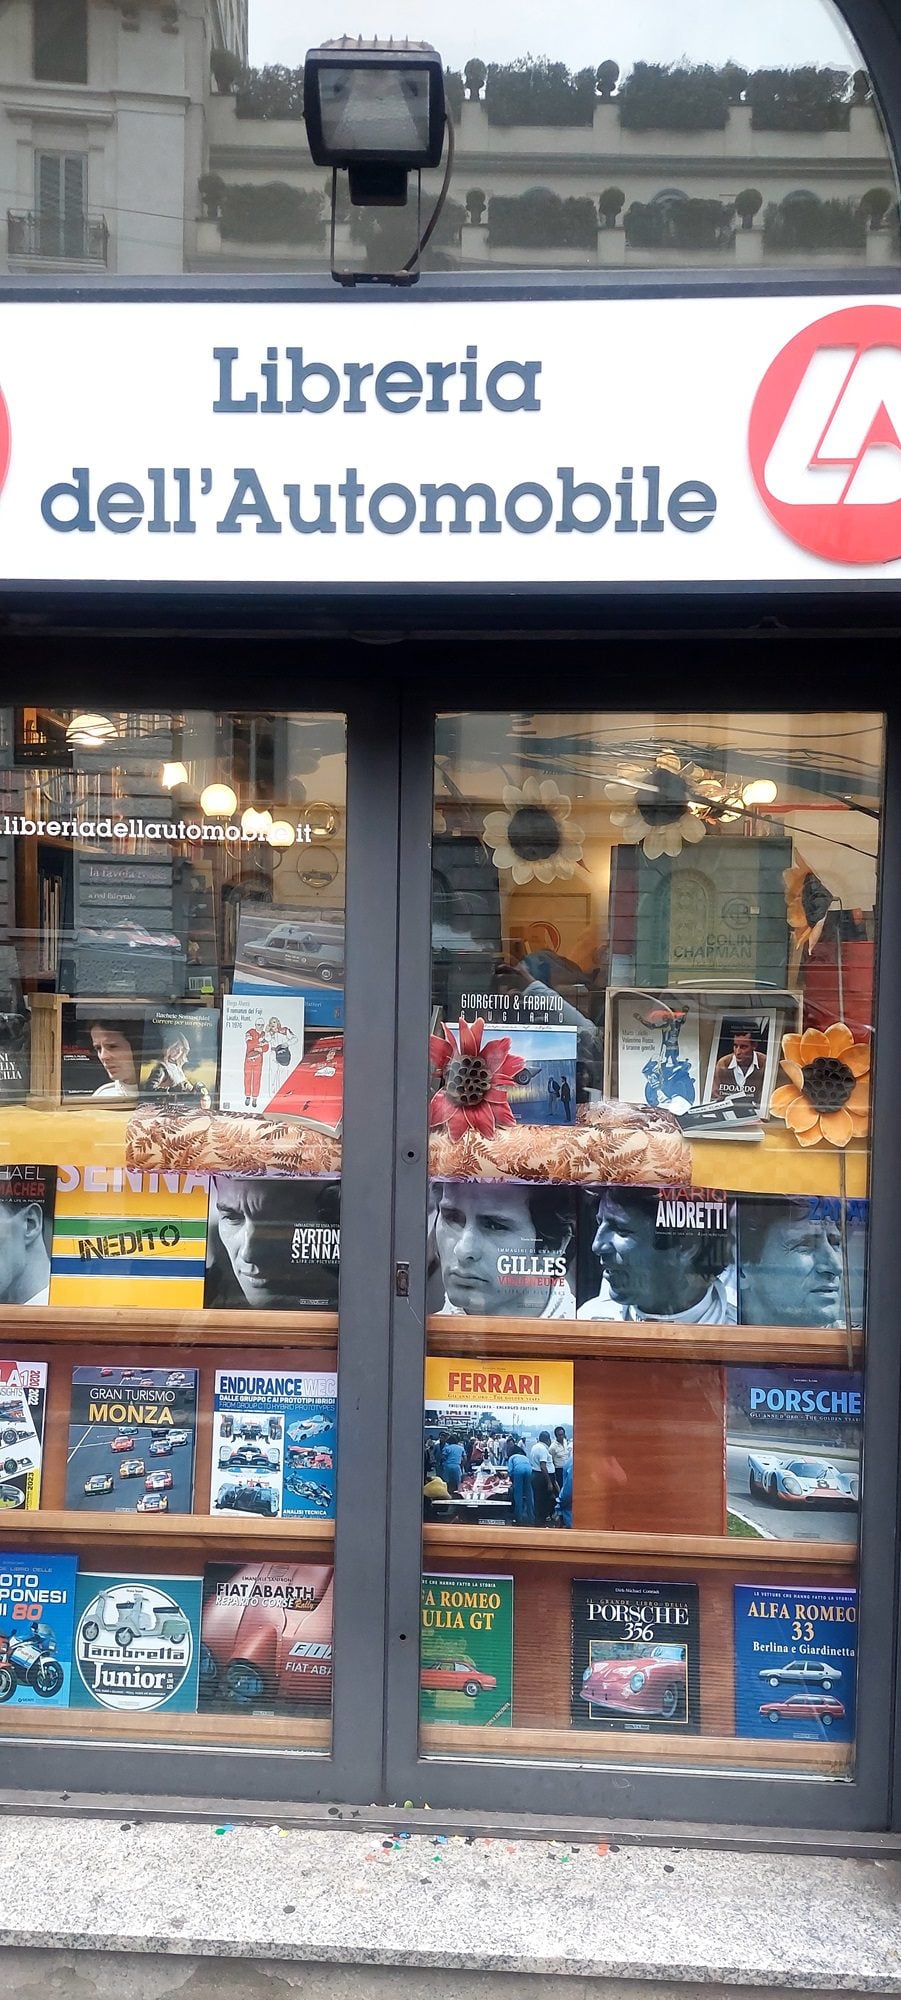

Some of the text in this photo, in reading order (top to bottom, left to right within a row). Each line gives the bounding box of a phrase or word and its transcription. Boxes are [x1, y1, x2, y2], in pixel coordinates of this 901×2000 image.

[213, 345, 542, 413] Libreria
[41, 466, 717, 533] dell’Automobile
[706, 933, 752, 947] COLIN
[674, 945, 752, 959] CHAPMAN
[461, 993, 564, 1011] GIORGETTO & FABRIZIO
[656, 1200, 728, 1230] ANDRETTI
[78, 1224, 180, 1262] INEDITO
[292, 1228, 340, 1245] AYRTON
[291, 1243, 340, 1260] SENNA
[497, 1254, 567, 1277] GILLES
[498, 1275, 565, 1288] VILLENEUVE
[219, 1375, 336, 1397] ENDURANCE WEC
[448, 1371, 540, 1395] FERRARI
[90, 1387, 176, 1403] GRAN TURISMO
[750, 1387, 862, 1414] PORSCHE
[89, 1402, 175, 1426] MONZA
[27, 1472, 35, 1491] 2023
[0, 1573, 39, 1588] OTO
[0, 1588, 67, 1604] PONESI
[216, 1582, 315, 1600] FIAT ABARTH
[440, 1590, 501, 1610] ROMEO
[12, 1603, 43, 1621] 80
[215, 1595, 316, 1611] REPARTO CORSE Rally
[747, 1601, 857, 1623] ALFA ROMEO
[469, 1611, 495, 1631] GT
[586, 1603, 689, 1626] PORSCHE
[620, 1622, 656, 1642] 356
[791, 1621, 815, 1642] 33
[753, 1641, 856, 1657] Berlina e Giardinetta
[92, 1662, 166, 1690] Junior
[285, 1661, 309, 1673] FIAT
